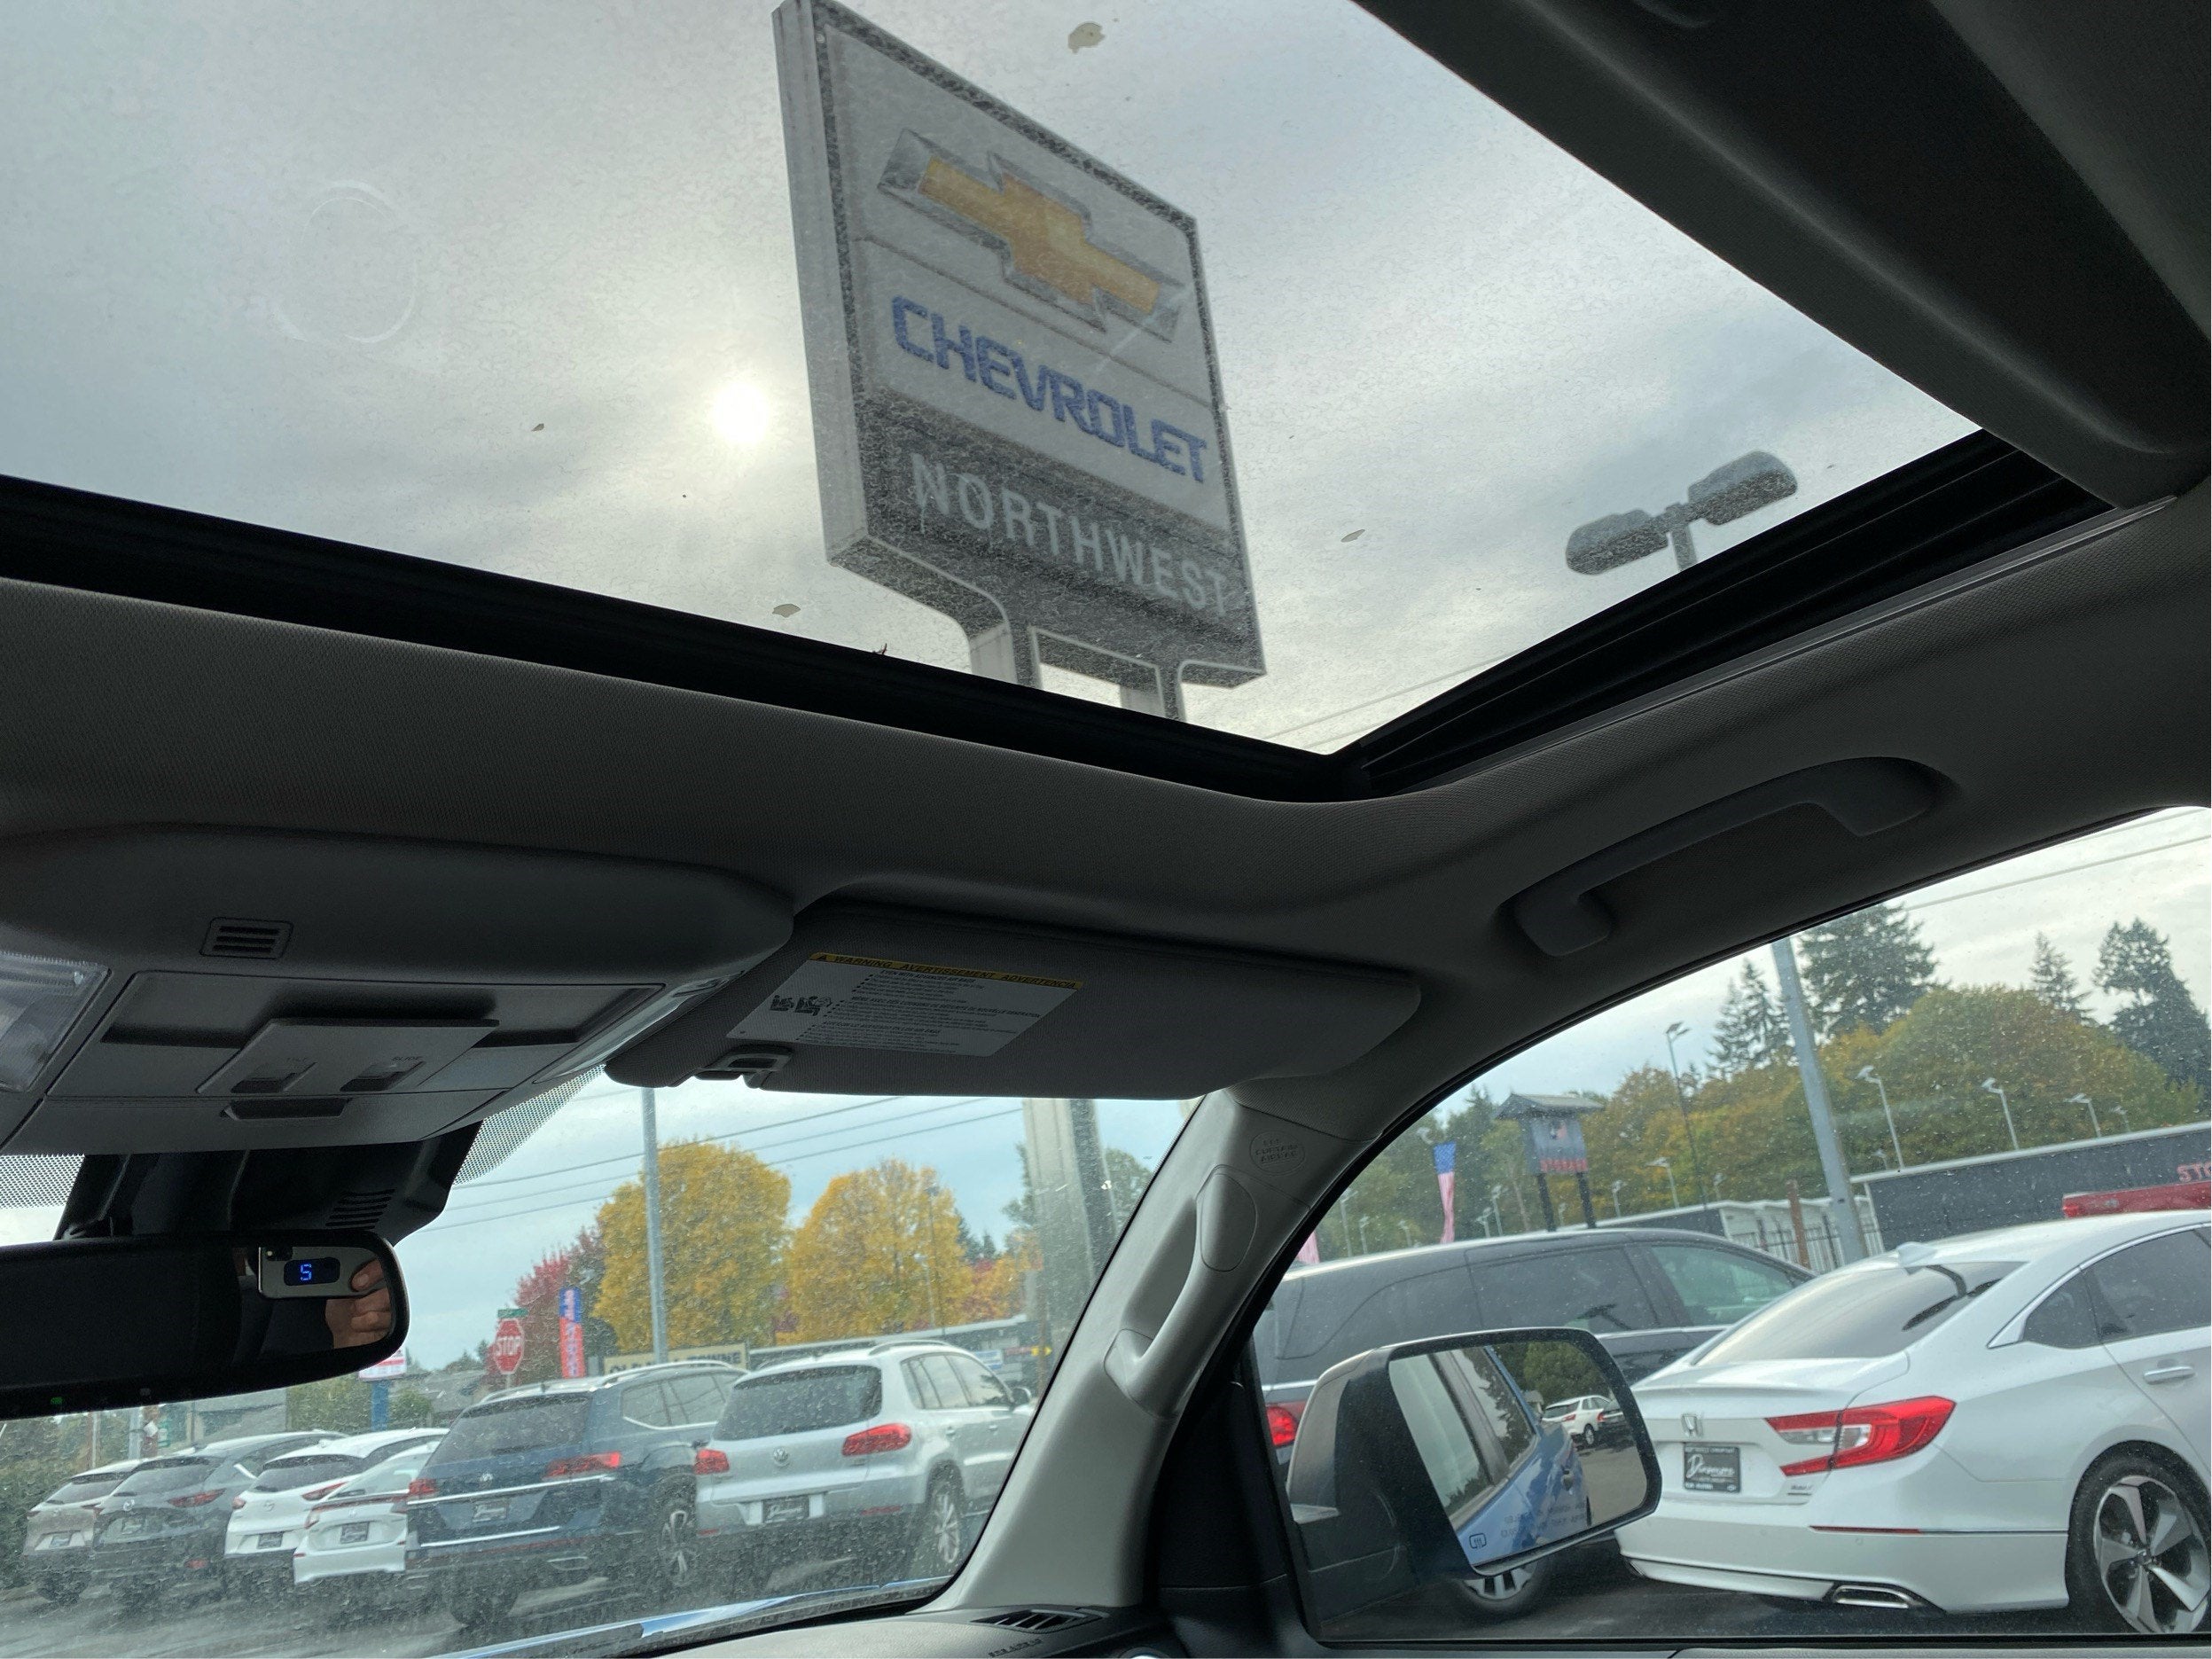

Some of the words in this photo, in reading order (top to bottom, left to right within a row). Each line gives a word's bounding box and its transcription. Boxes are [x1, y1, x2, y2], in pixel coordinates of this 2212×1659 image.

[891, 295, 1208, 483] CHEVROLET
[911, 453, 1227, 616] NORTHWEST
[834, 956, 893, 967] WARNING
[900, 964, 996, 979] AVERTISSEMENT
[1001, 974, 1076, 988] ADVERTENCIA
[494, 1335, 521, 1357] STOP
